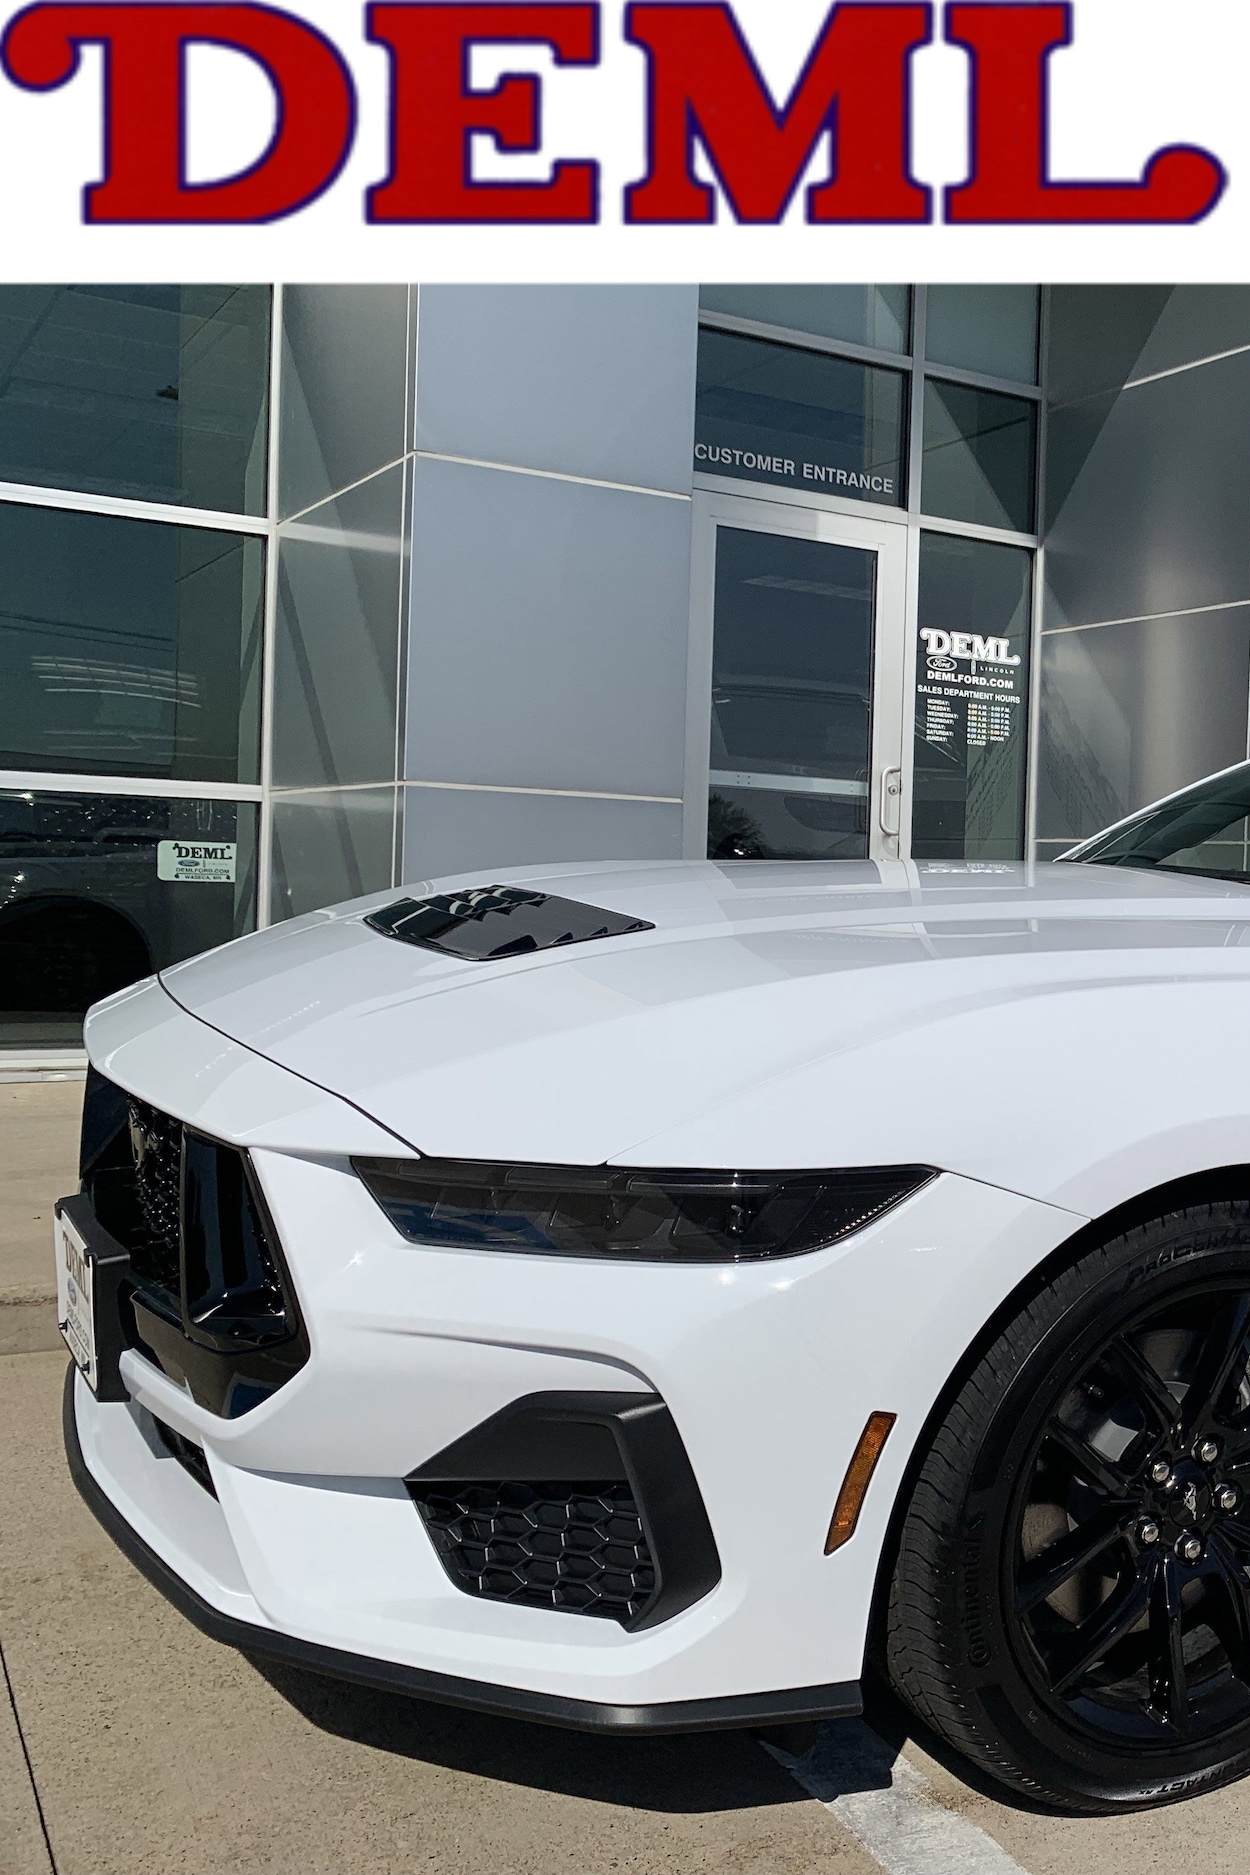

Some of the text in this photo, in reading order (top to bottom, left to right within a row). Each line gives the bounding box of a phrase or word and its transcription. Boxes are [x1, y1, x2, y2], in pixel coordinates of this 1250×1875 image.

[694, 443, 894, 494] CUSTOMER ENTRANCE
[919, 627, 1021, 667] DEML
[932, 658, 952, 669] Ford
[980, 665, 1015, 675] LINCOLN
[927, 670, 1015, 689] DEMLFORD.COM
[917, 684, 1021, 704] SALES DEPARTMENT HOURS
[173, 846, 232, 860] DEML
